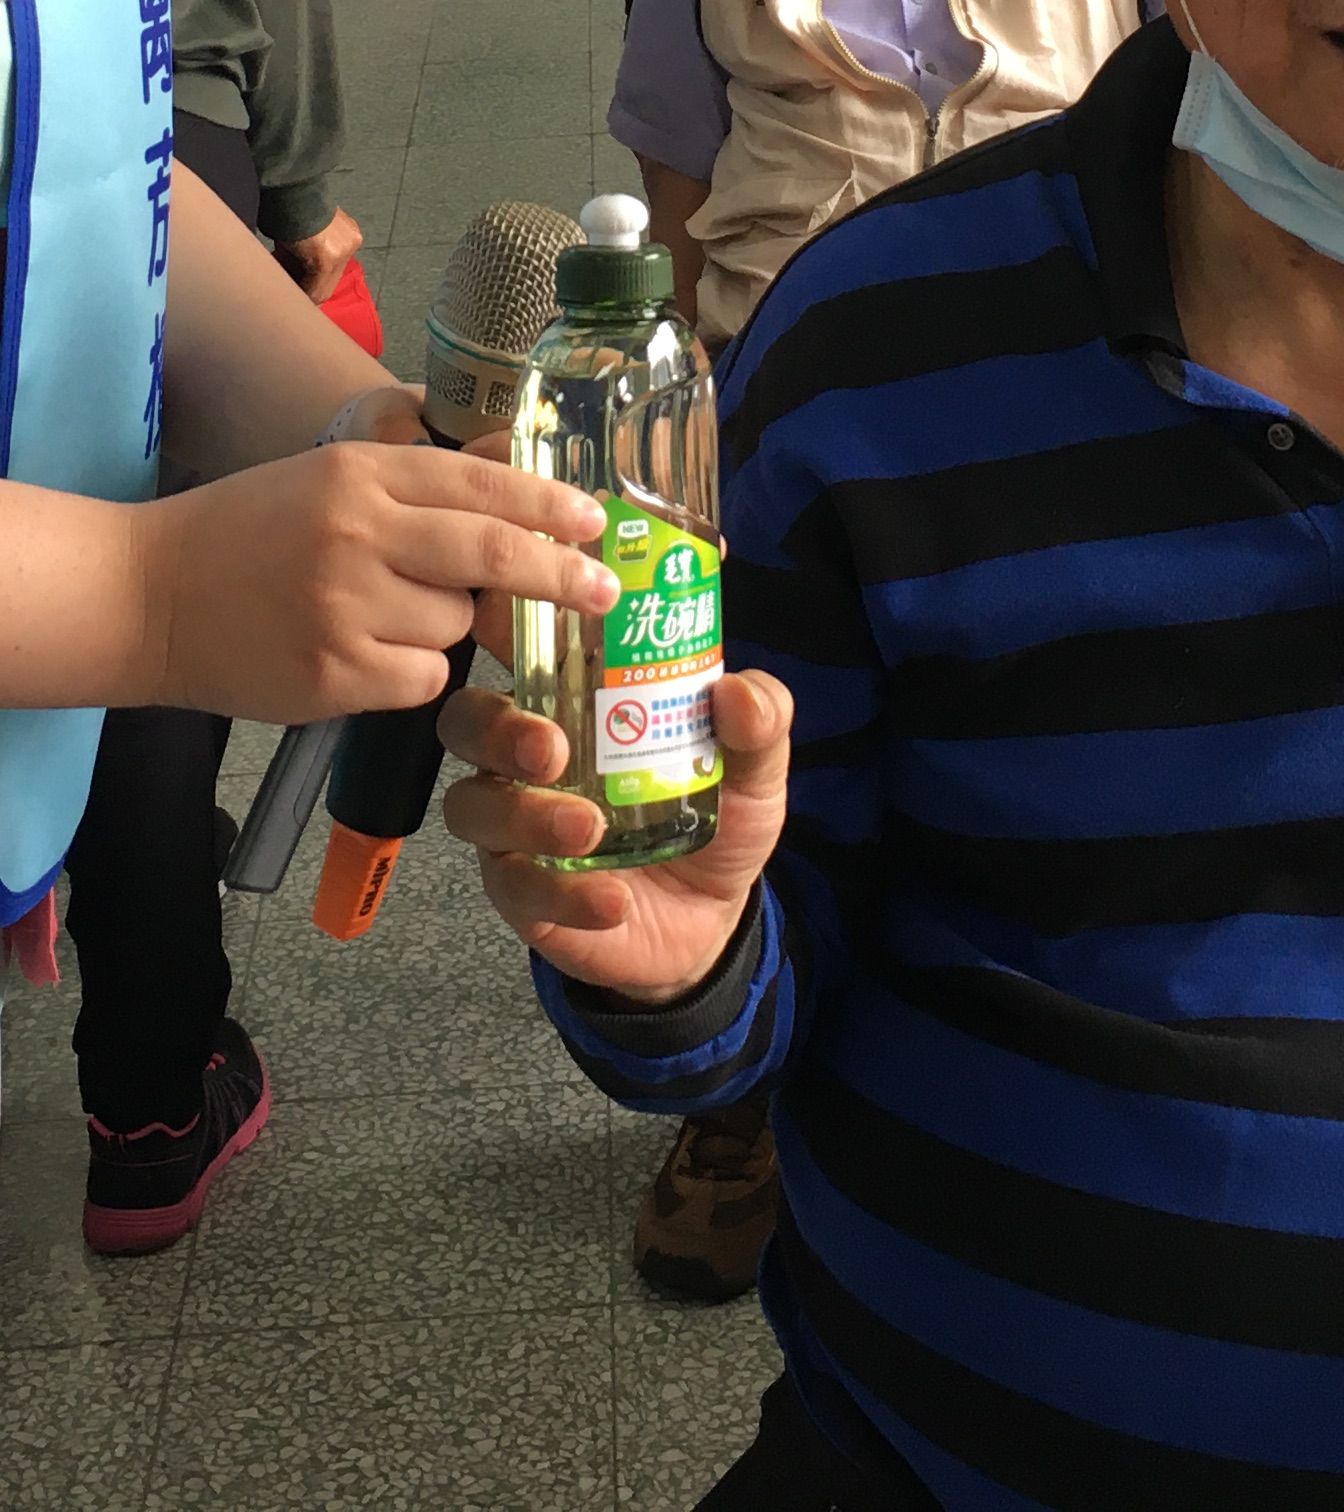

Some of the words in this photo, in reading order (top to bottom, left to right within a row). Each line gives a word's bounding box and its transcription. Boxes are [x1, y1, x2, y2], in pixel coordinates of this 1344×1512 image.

[622, 523, 644, 534] NEW
[620, 589, 716, 647] 洗碗精
[360, 855, 391, 916] MIPRO
